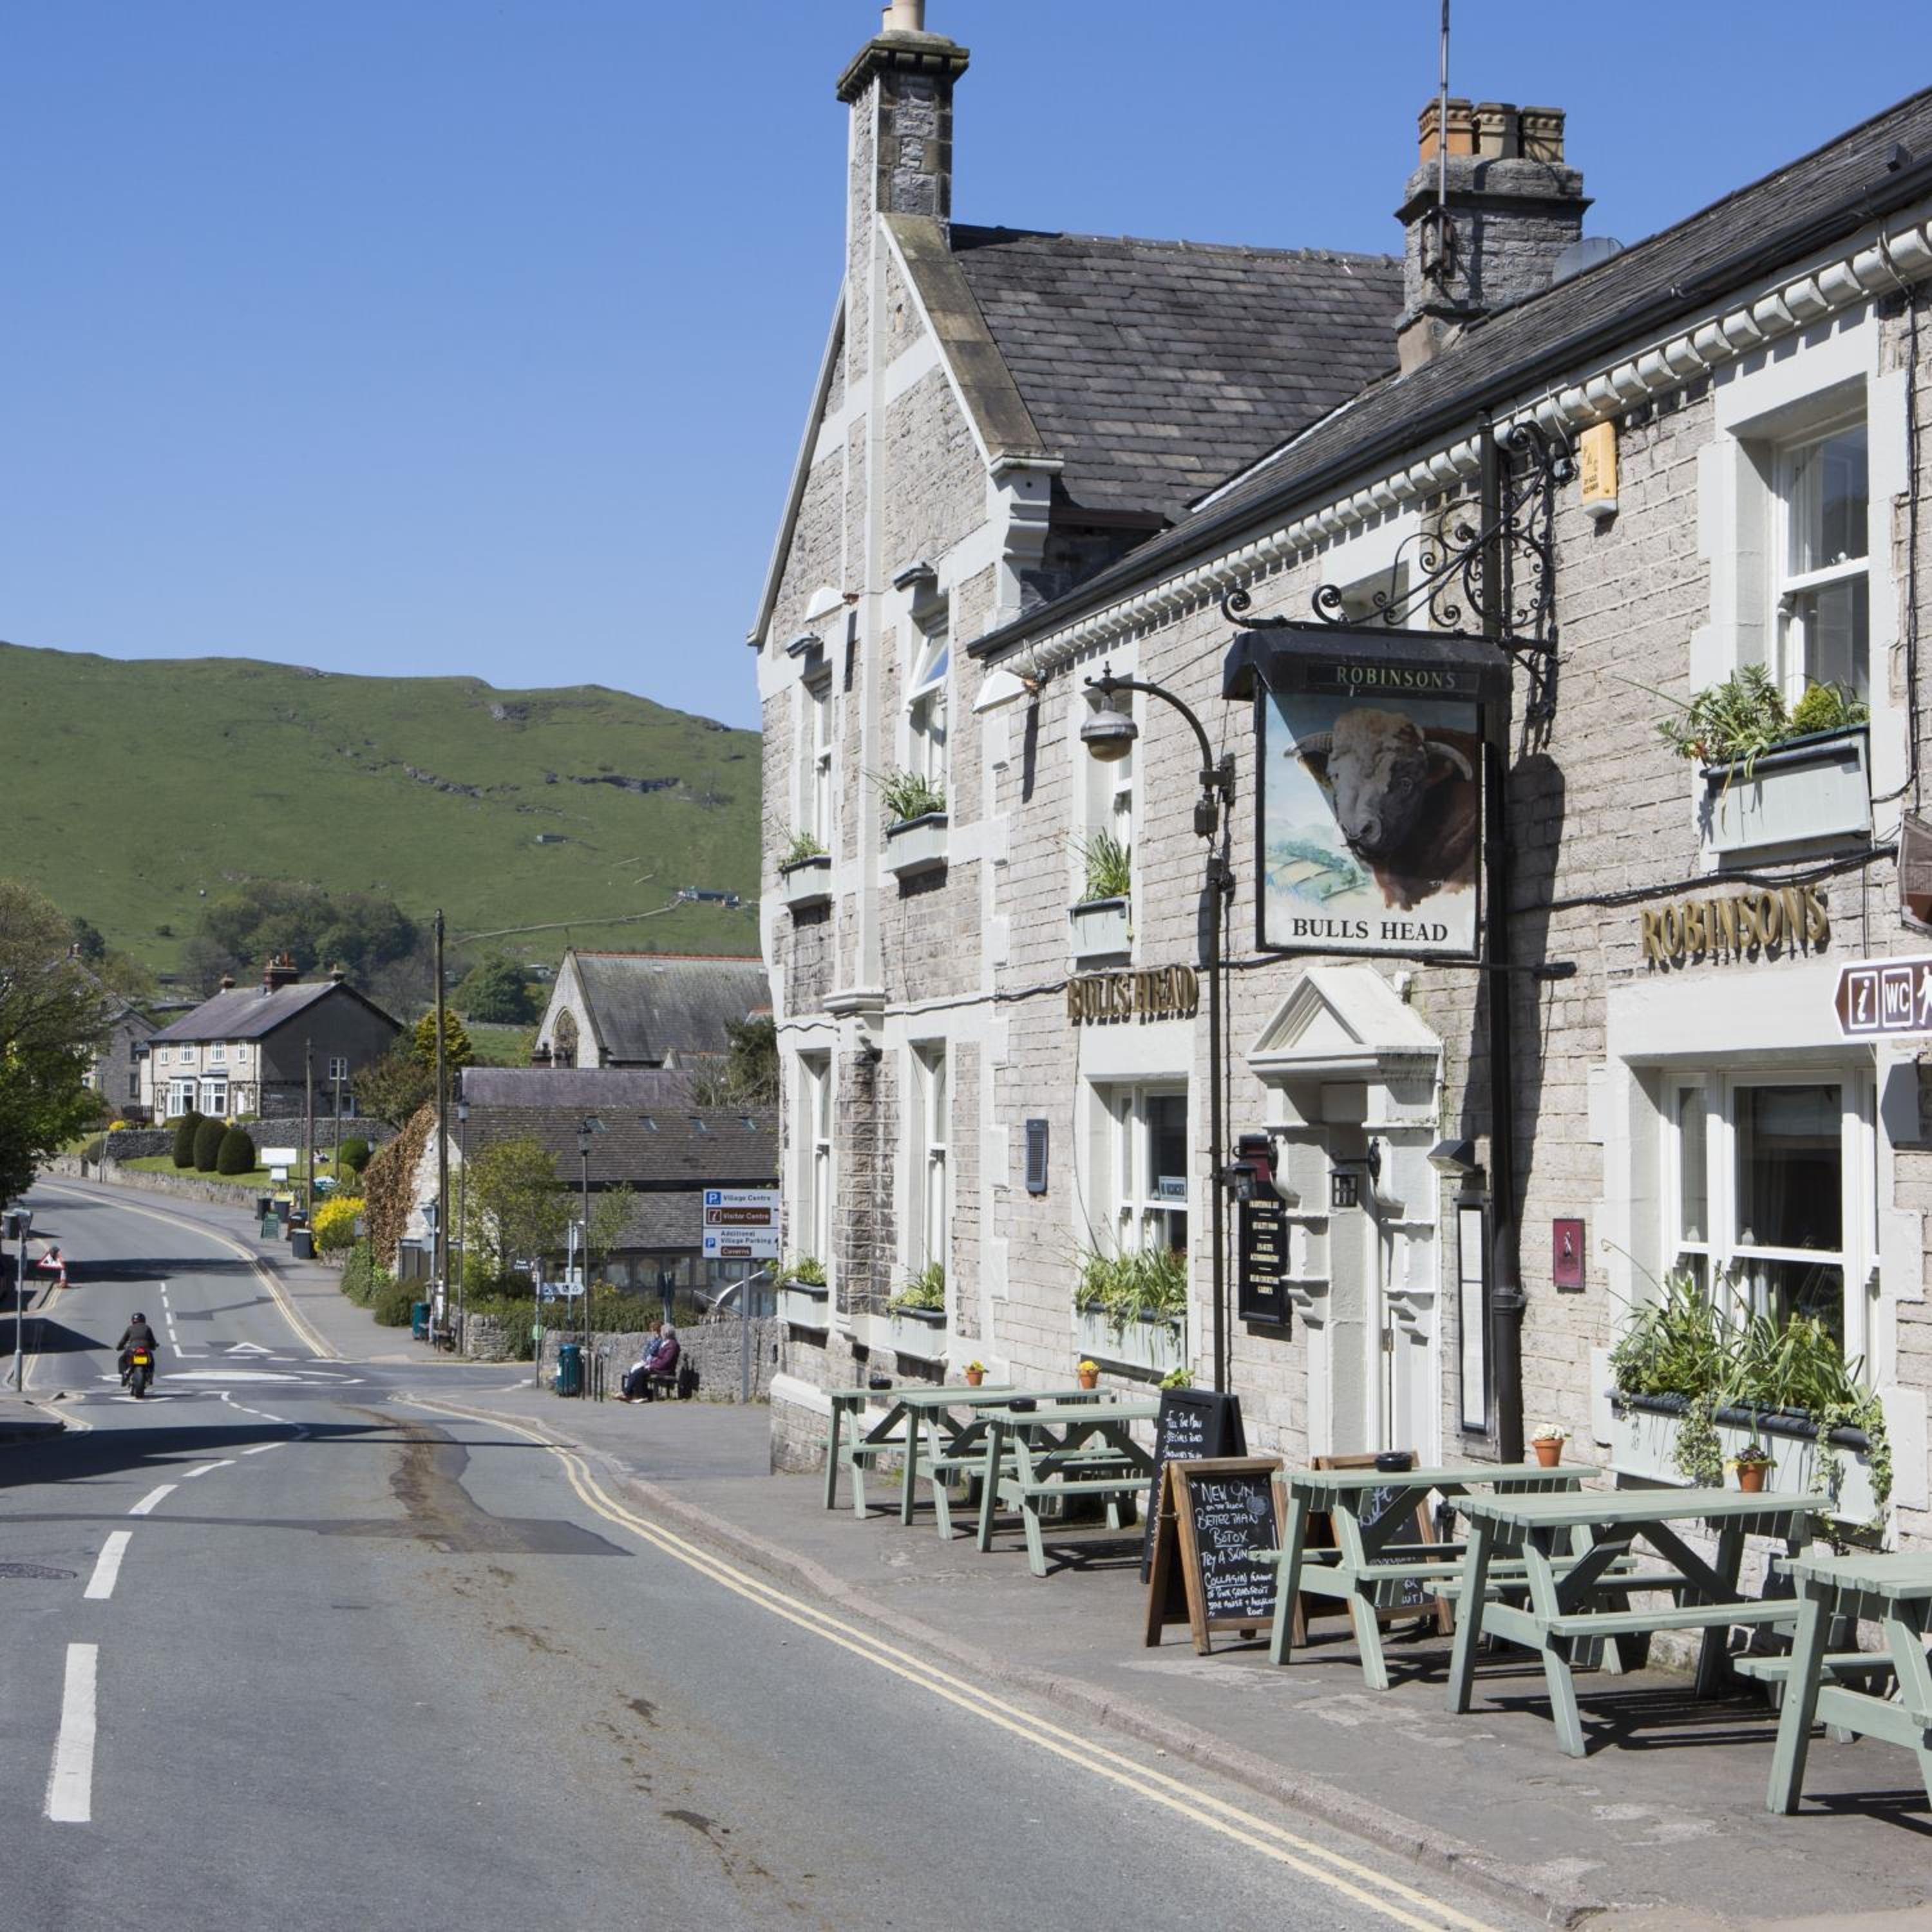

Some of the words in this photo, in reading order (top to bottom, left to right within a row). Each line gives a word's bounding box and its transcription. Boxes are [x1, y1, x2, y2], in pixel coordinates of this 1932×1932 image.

[1336, 665, 1455, 688] ROBINSONS
[1292, 918, 1369, 939] BULLS
[1380, 922, 1448, 942] HEAD
[1640, 886, 1828, 961] ROBINSONS
[1133, 965, 1200, 1013] HEAD
[1885, 981, 1910, 1014] WC
[1232, 1513, 1258, 1525] THAN
